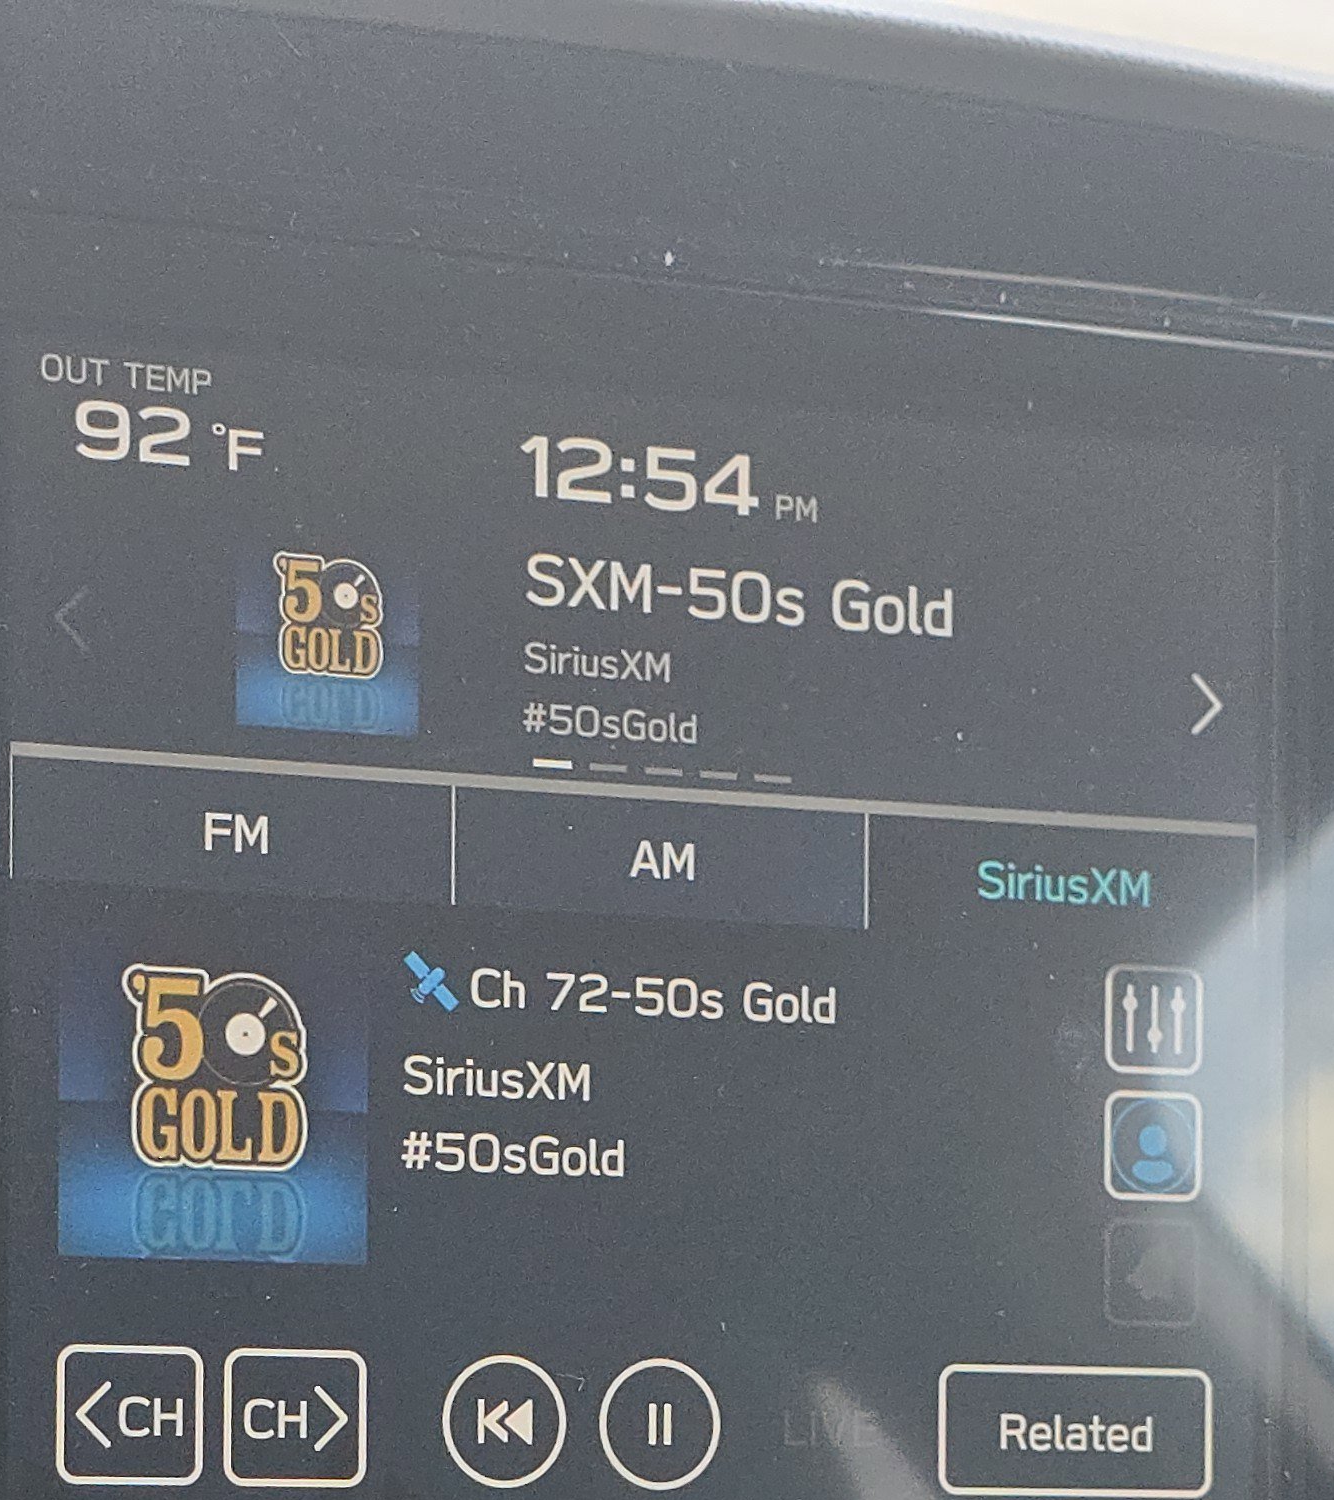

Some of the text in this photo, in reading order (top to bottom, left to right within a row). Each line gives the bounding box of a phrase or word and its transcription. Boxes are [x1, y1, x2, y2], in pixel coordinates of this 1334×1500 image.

[41, 354, 212, 395] OUT TEMP
[74, 400, 190, 466] 92
[520, 436, 818, 524] 12:54 PM
[525, 553, 954, 636] SXM-50s Gold
[284, 626, 379, 676] GOLD
[524, 642, 671, 683] SiriusXM
[523, 703, 698, 744] #50sGold
[204, 812, 268, 855] FM
[630, 840, 695, 881] AM
[977, 860, 1151, 907] SiriusXM
[470, 967, 836, 1025] Ch 72-50s Gold
[402, 1055, 591, 1102] SiriusXM
[140, 1088, 300, 1164] GOLD
[400, 1131, 625, 1178] #50sGold
[118, 1396, 184, 1438] CH
[243, 1398, 308, 1439] CH
[999, 1413, 1154, 1452] Related
